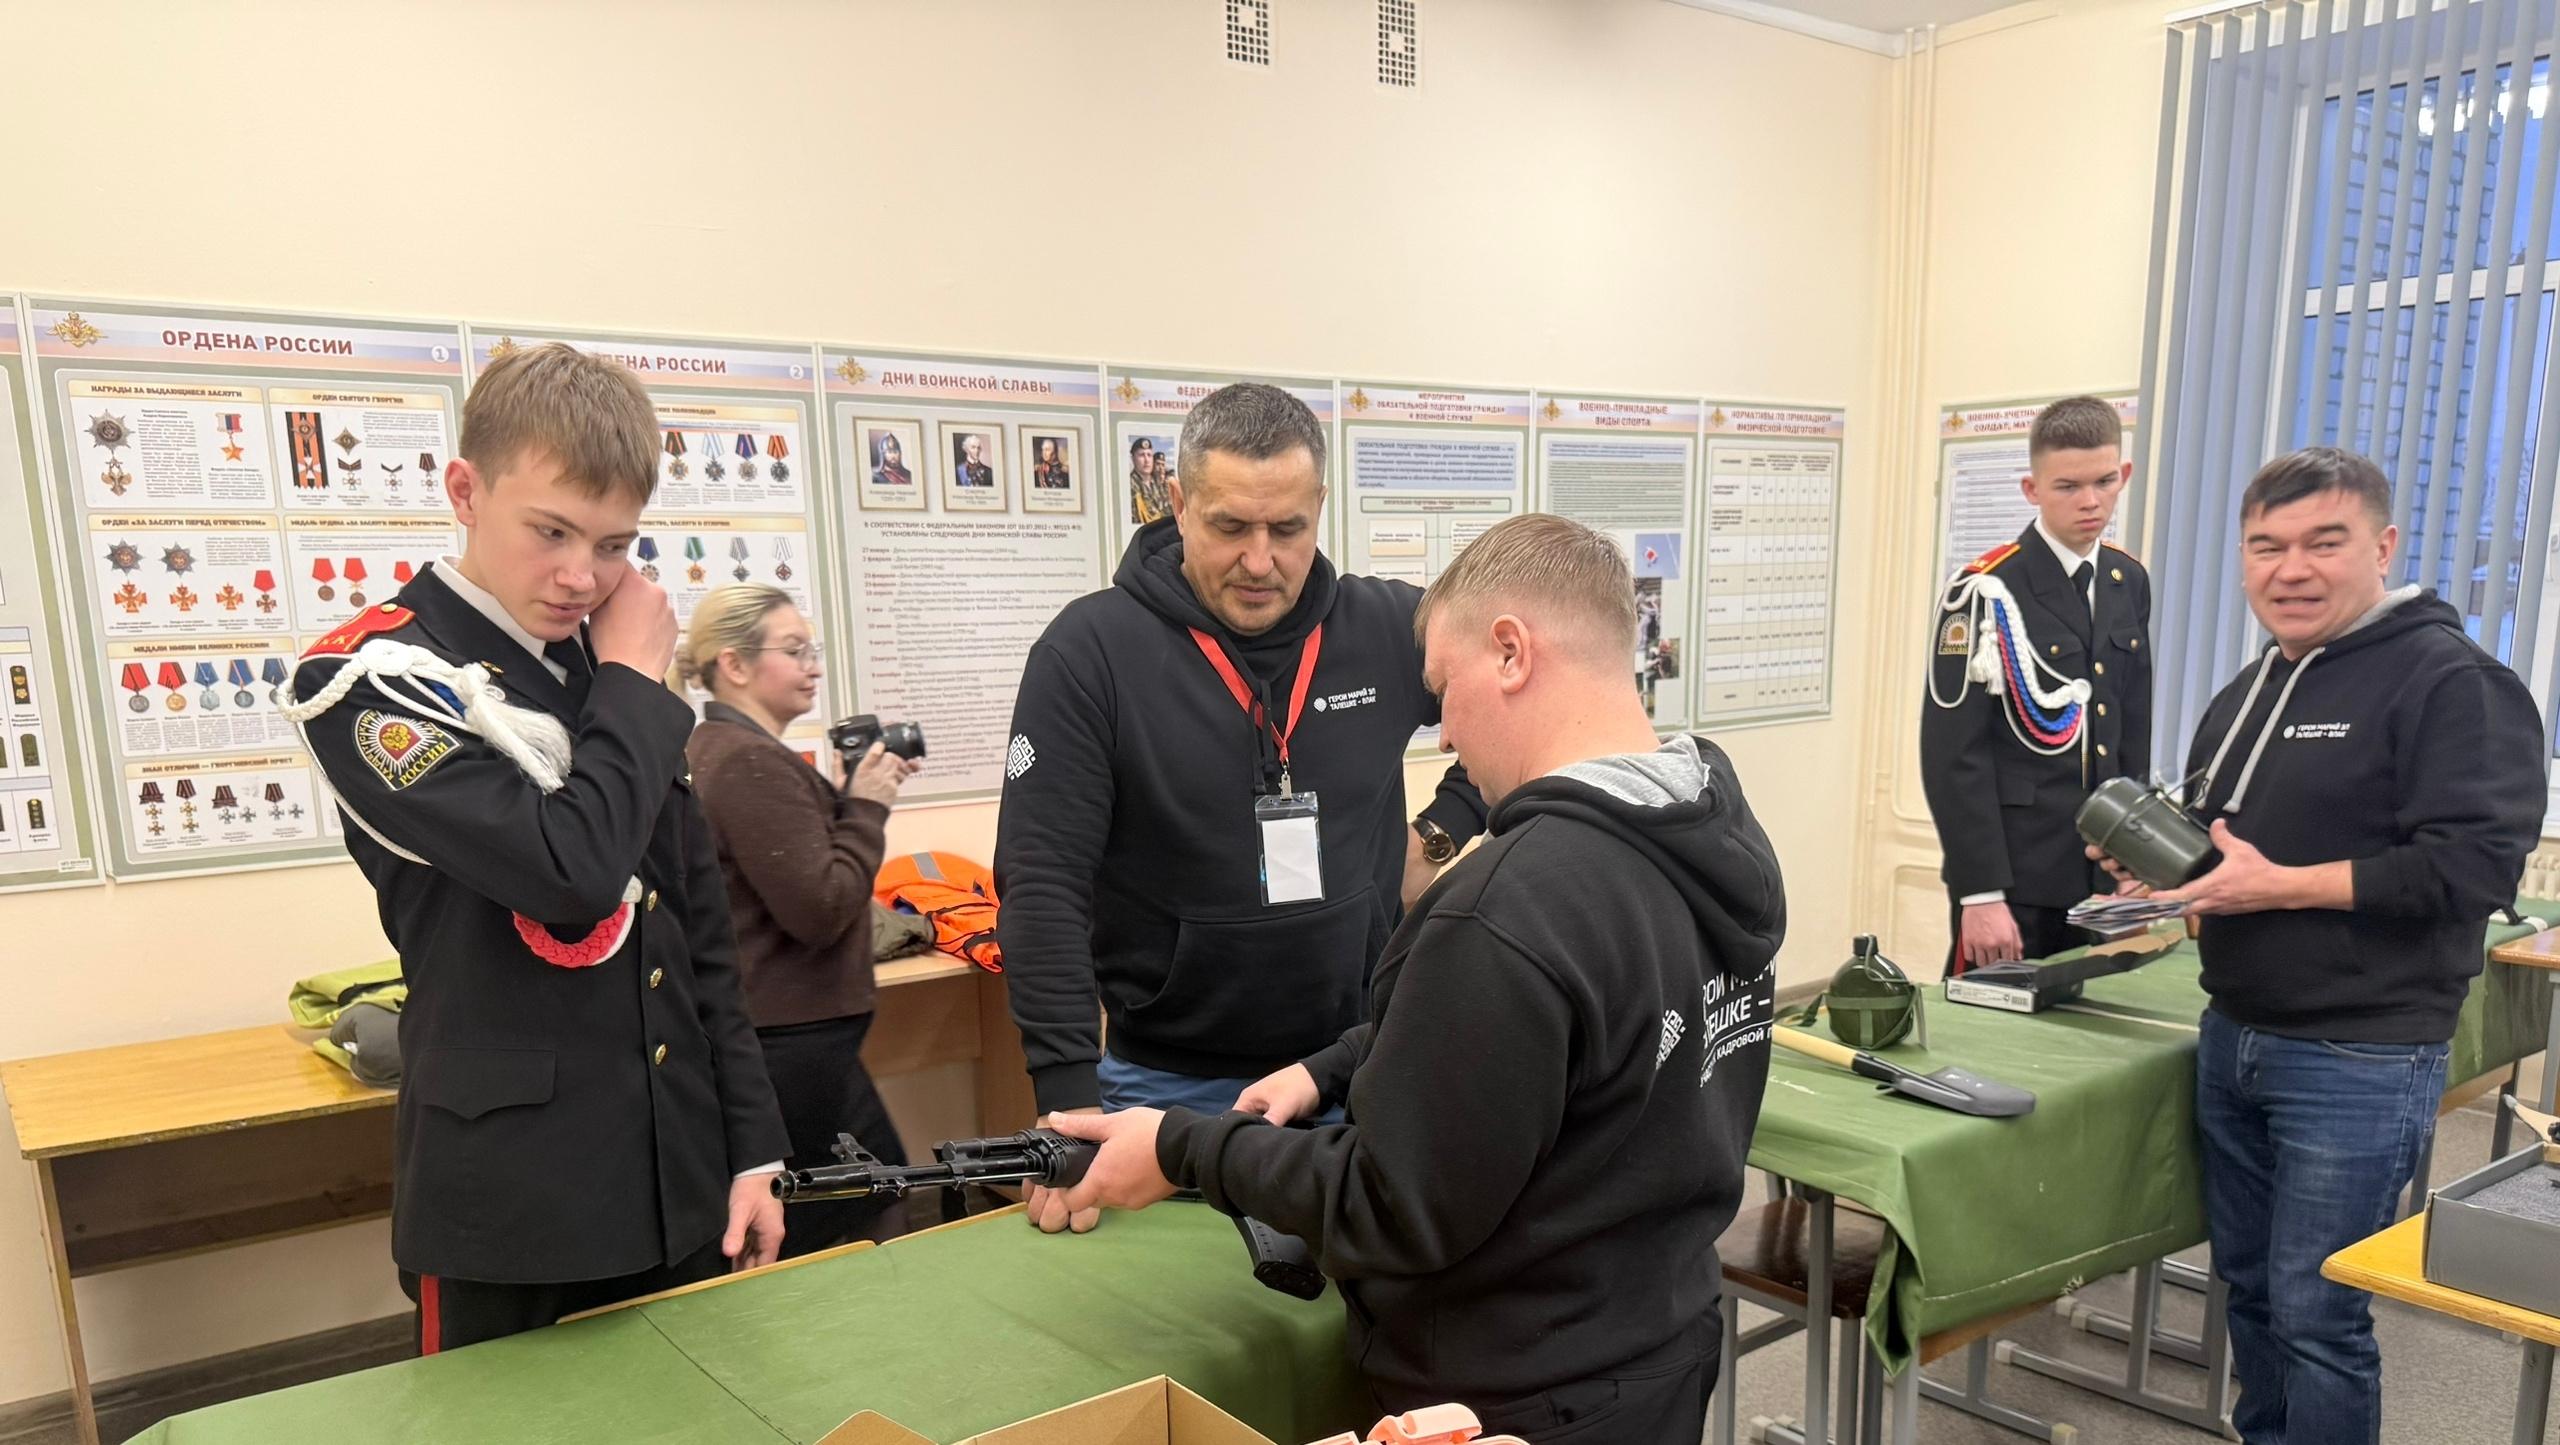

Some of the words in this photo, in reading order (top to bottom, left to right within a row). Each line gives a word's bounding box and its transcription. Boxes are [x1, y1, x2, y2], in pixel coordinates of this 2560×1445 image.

[162, 330, 258, 351] ОРДЕНА
[265, 335, 353, 355] РОССИИ
[656, 356, 727, 374] РОССИИ
[91, 385, 132, 394] НАГРАДЫ
[881, 371, 914, 386] ДНИ
[919, 374, 998, 391] ВОИНСКОЙ
[1002, 378, 1052, 393] СЛАВЫ
[1579, 402, 1668, 415] ВОЕННО-ПРИКЛАДНЫЕ
[1595, 416, 1619, 426] ВИДЫ
[1621, 416, 1650, 426] СПОРТА
[102, 519, 129, 527] ОРДЕН
[133, 645, 167, 653] МЕДАЛИ
[1328, 693, 1347, 703] ГЕРОИ
[1348, 687, 1367, 699] МАРИЙ
[399, 742, 448, 785] РОССИИ
[1717, 1027, 1764, 1060] КАДРОВОЙ
